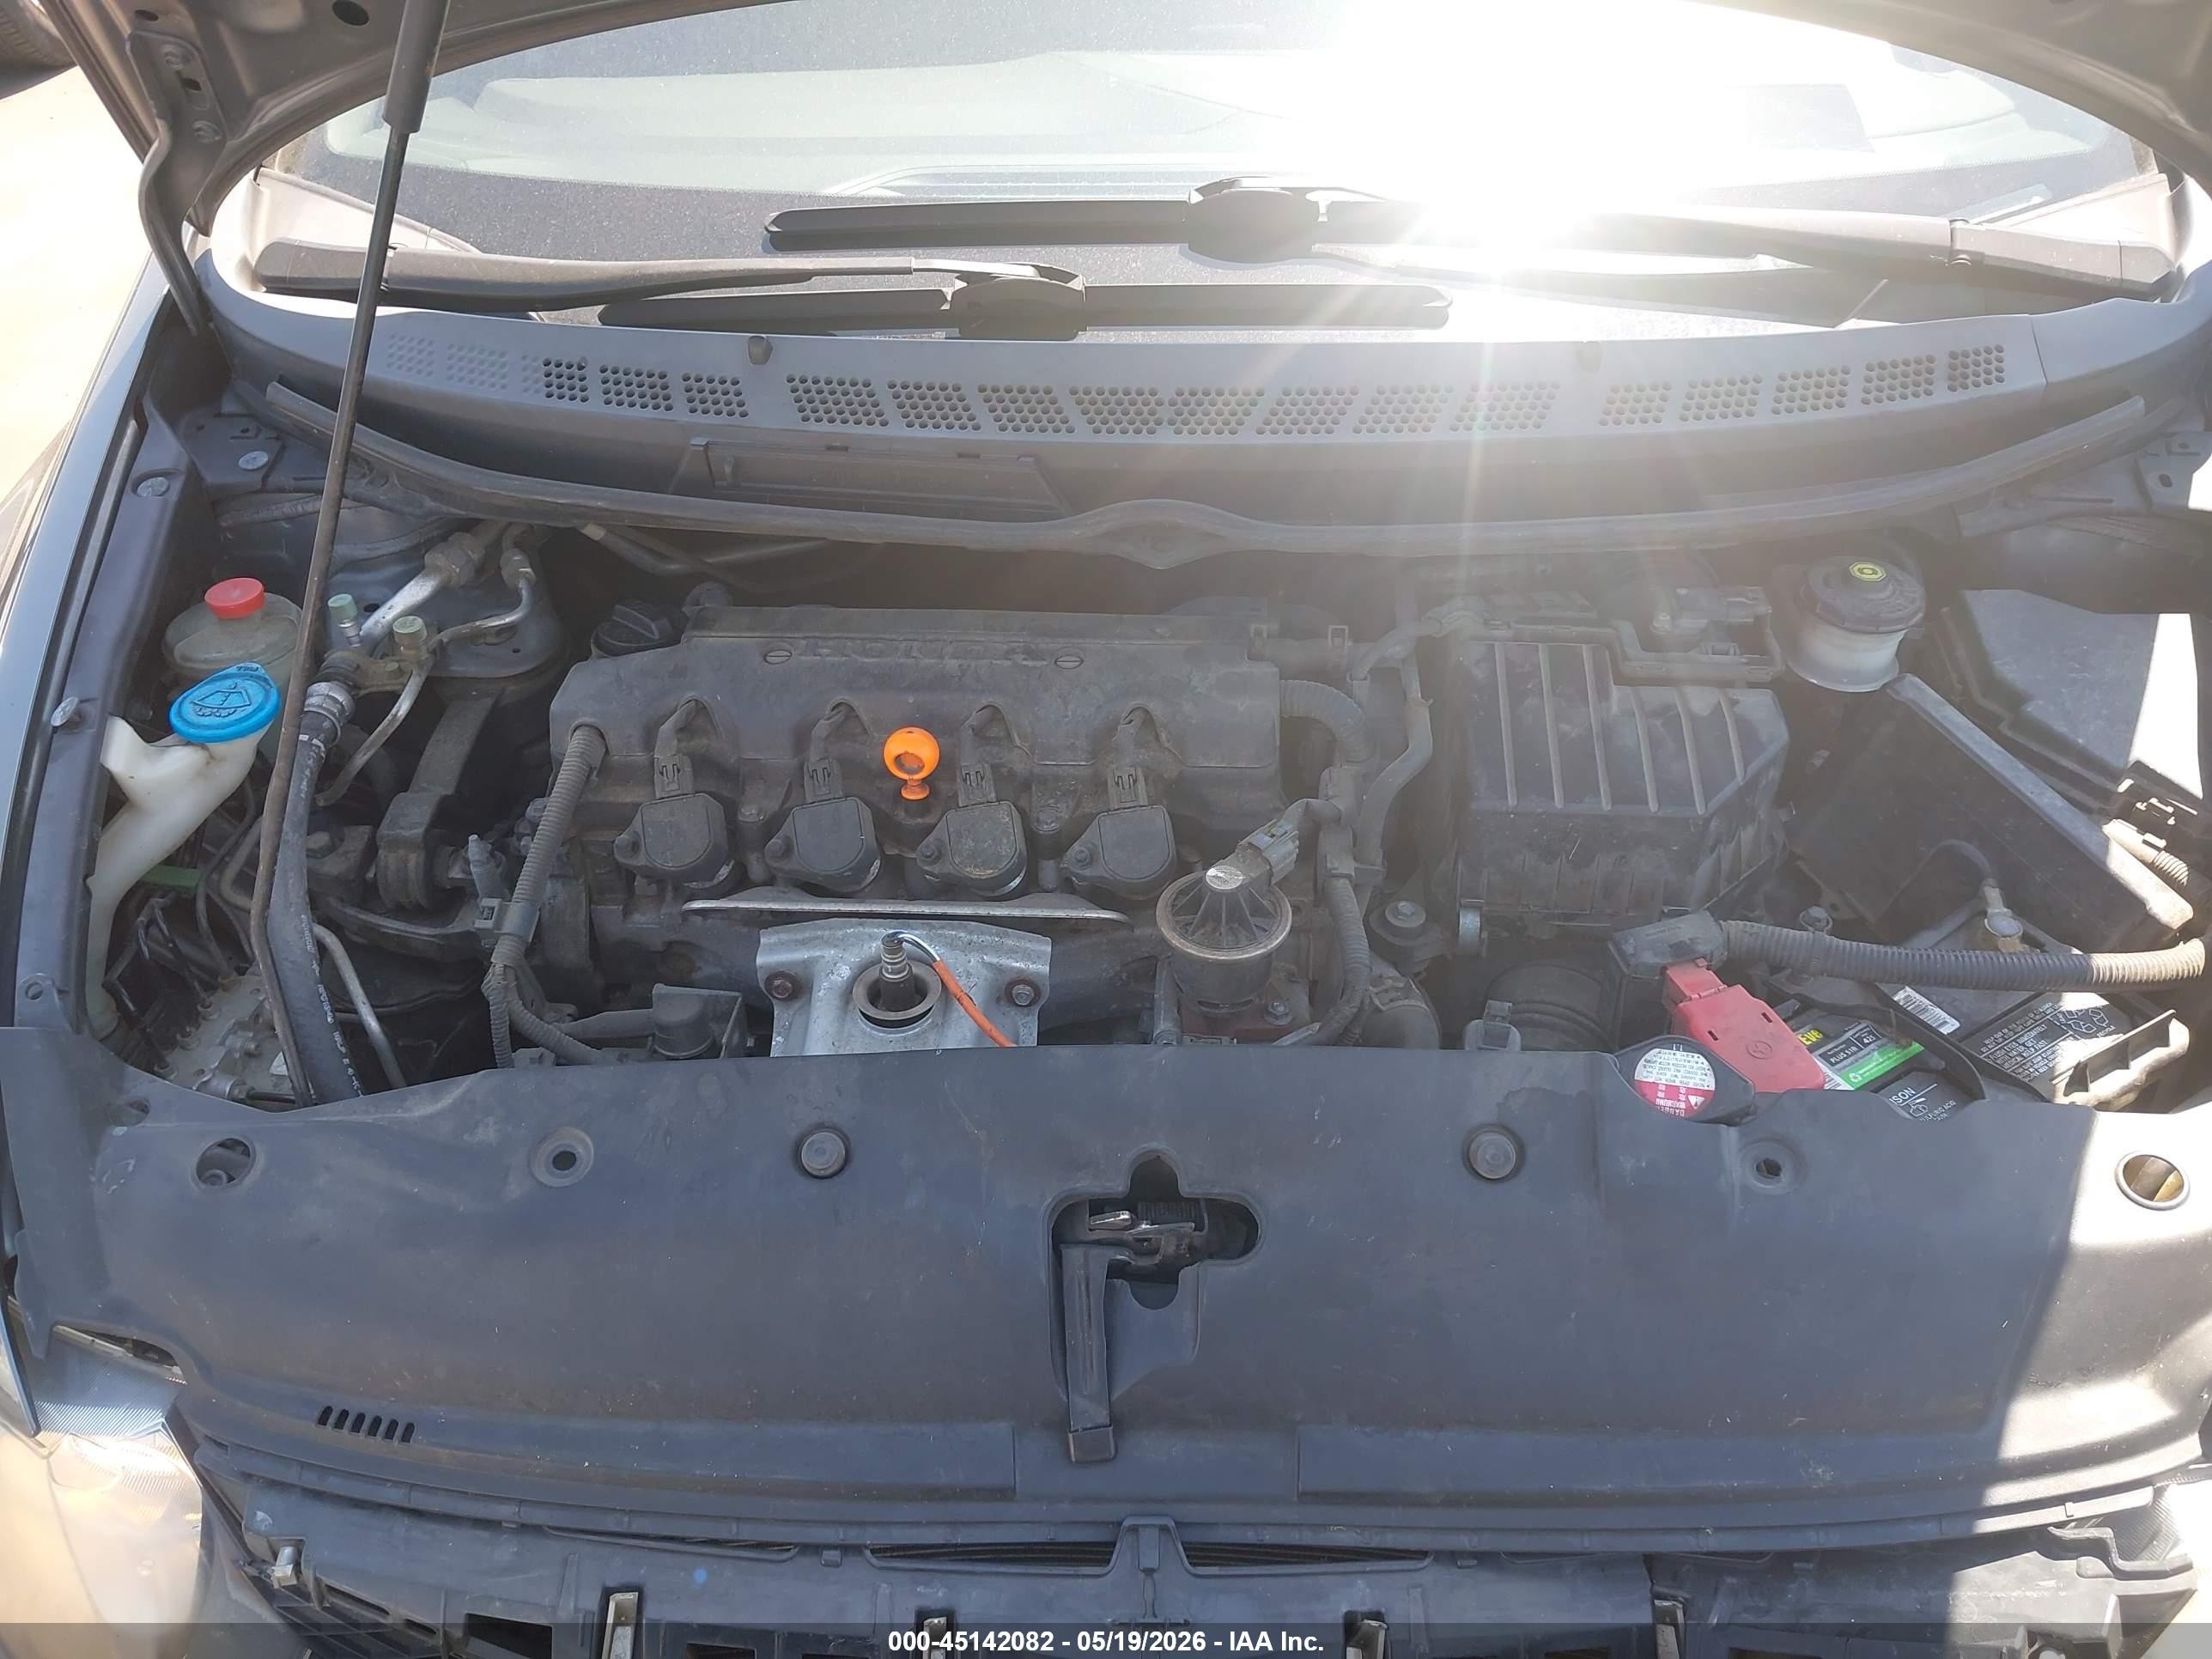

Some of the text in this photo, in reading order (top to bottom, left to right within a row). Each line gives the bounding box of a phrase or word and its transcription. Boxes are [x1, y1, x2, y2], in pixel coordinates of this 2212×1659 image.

[2002, 1041, 2020, 1052] EYES
[2021, 1047, 2037, 1057] HELP
[2033, 1039, 2048, 1049] FAST
[1829, 1051, 1846, 1063] PLUS
